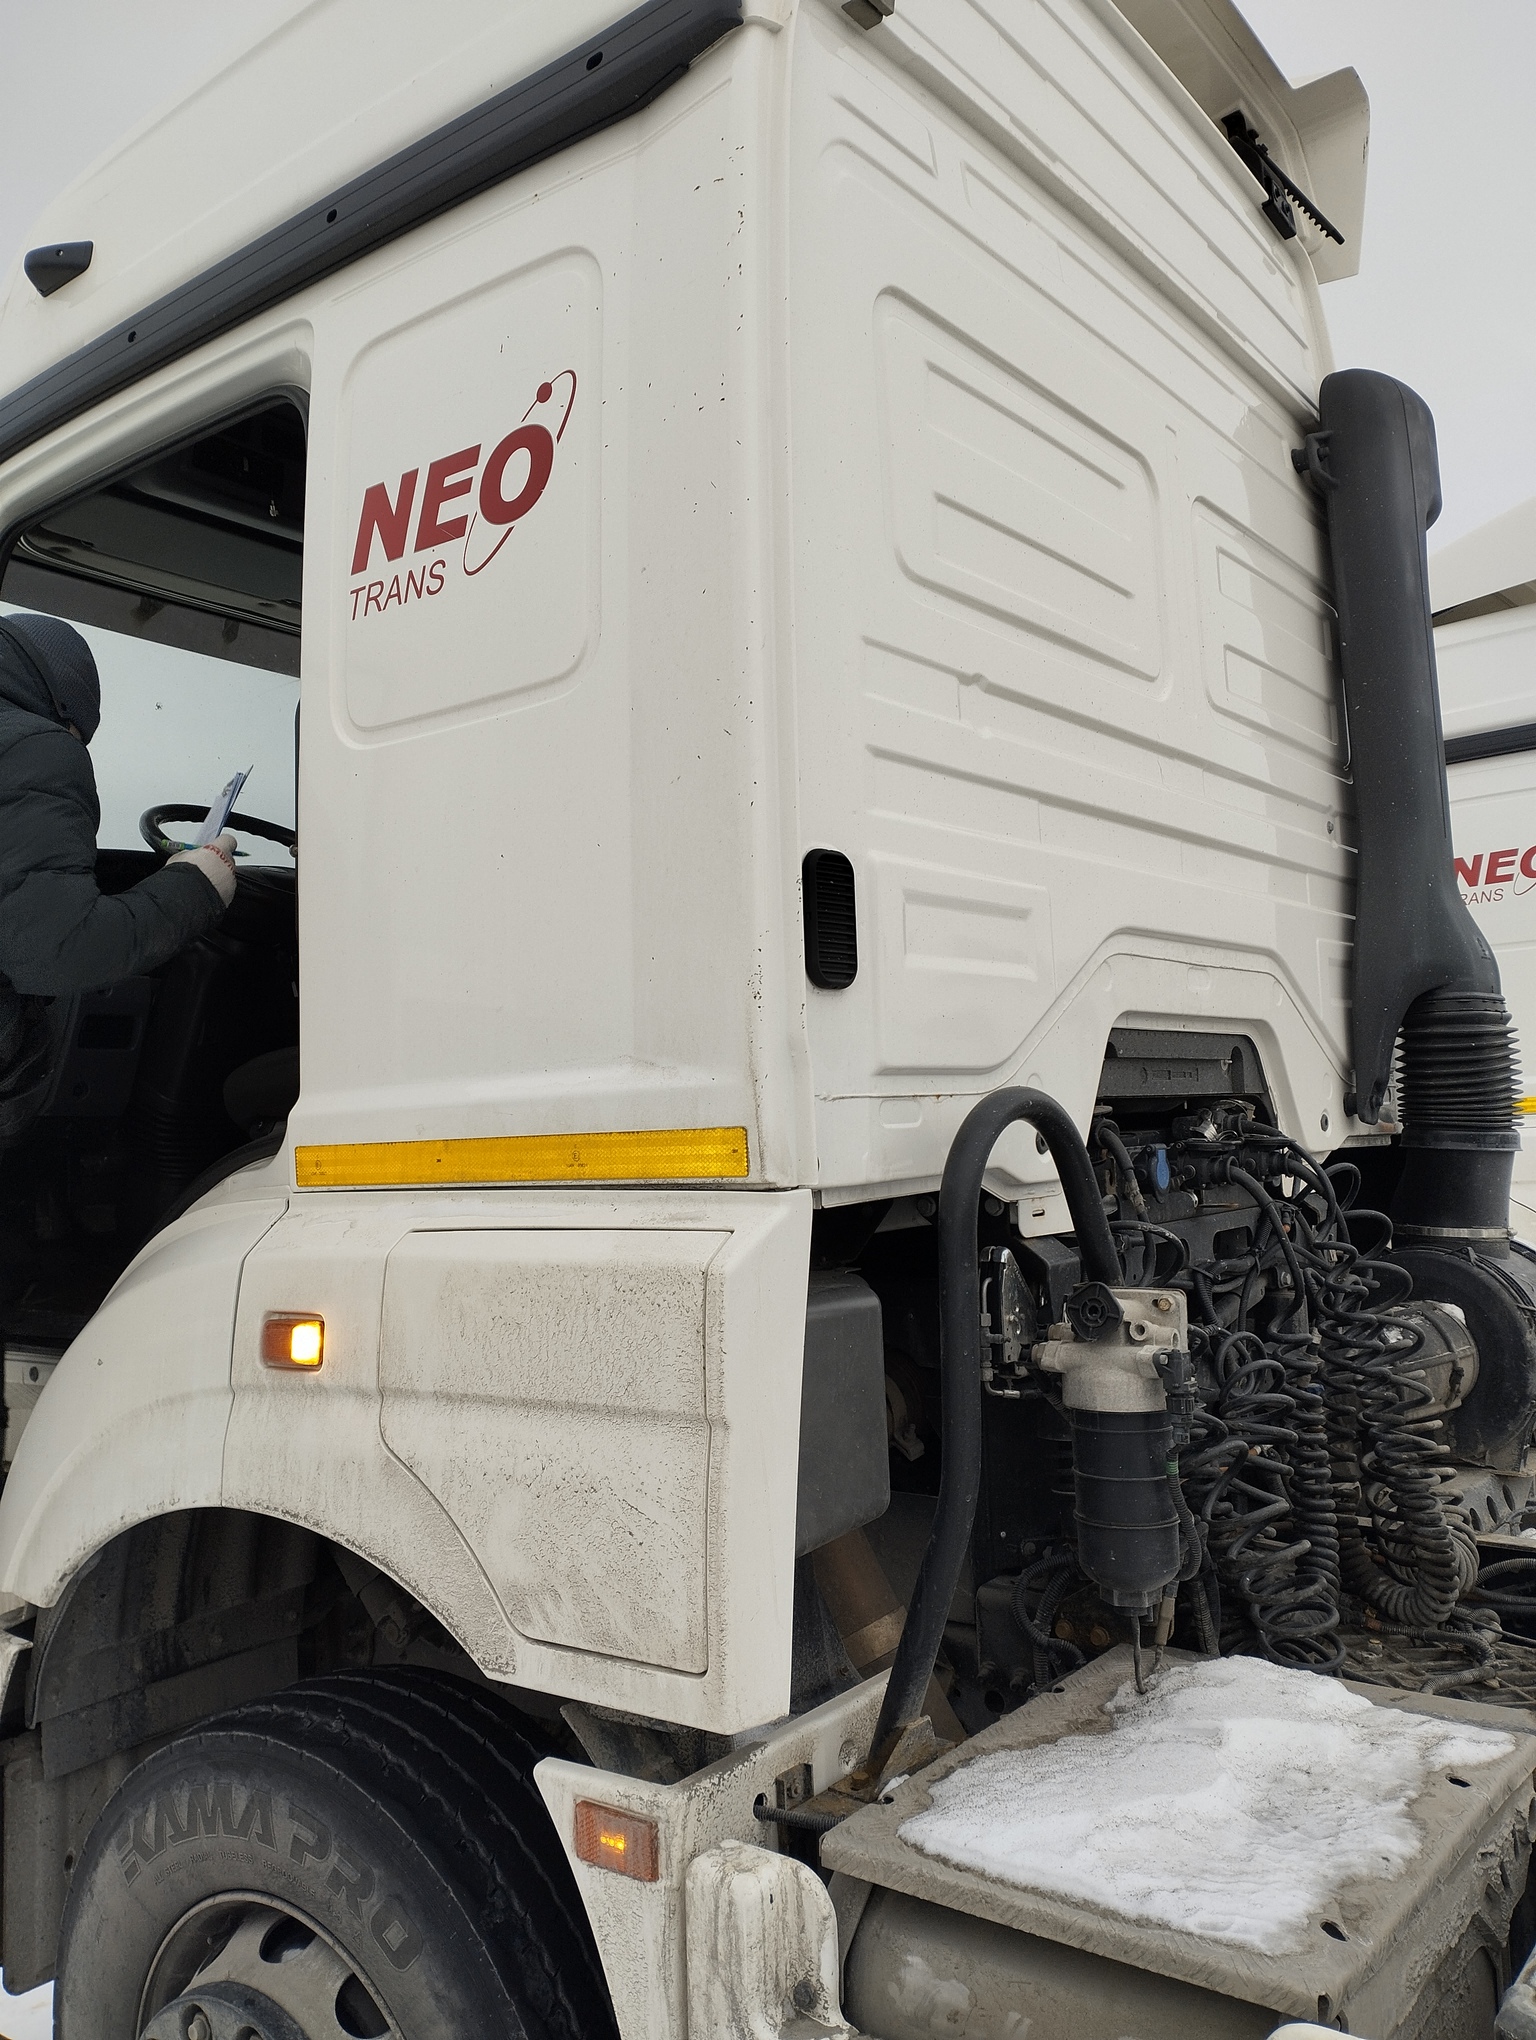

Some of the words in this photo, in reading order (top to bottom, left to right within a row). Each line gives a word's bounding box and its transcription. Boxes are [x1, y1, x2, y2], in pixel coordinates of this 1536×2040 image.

[351, 424, 554, 576] NEO
[350, 559, 446, 621] TRANS
[1460, 888, 1504, 906] RANS
[116, 1782, 279, 1887] KAMA
[288, 1803, 425, 1973] PRO
[164, 1861, 183, 1877] STEEL
[219, 1850, 255, 1864] TUBELESS
